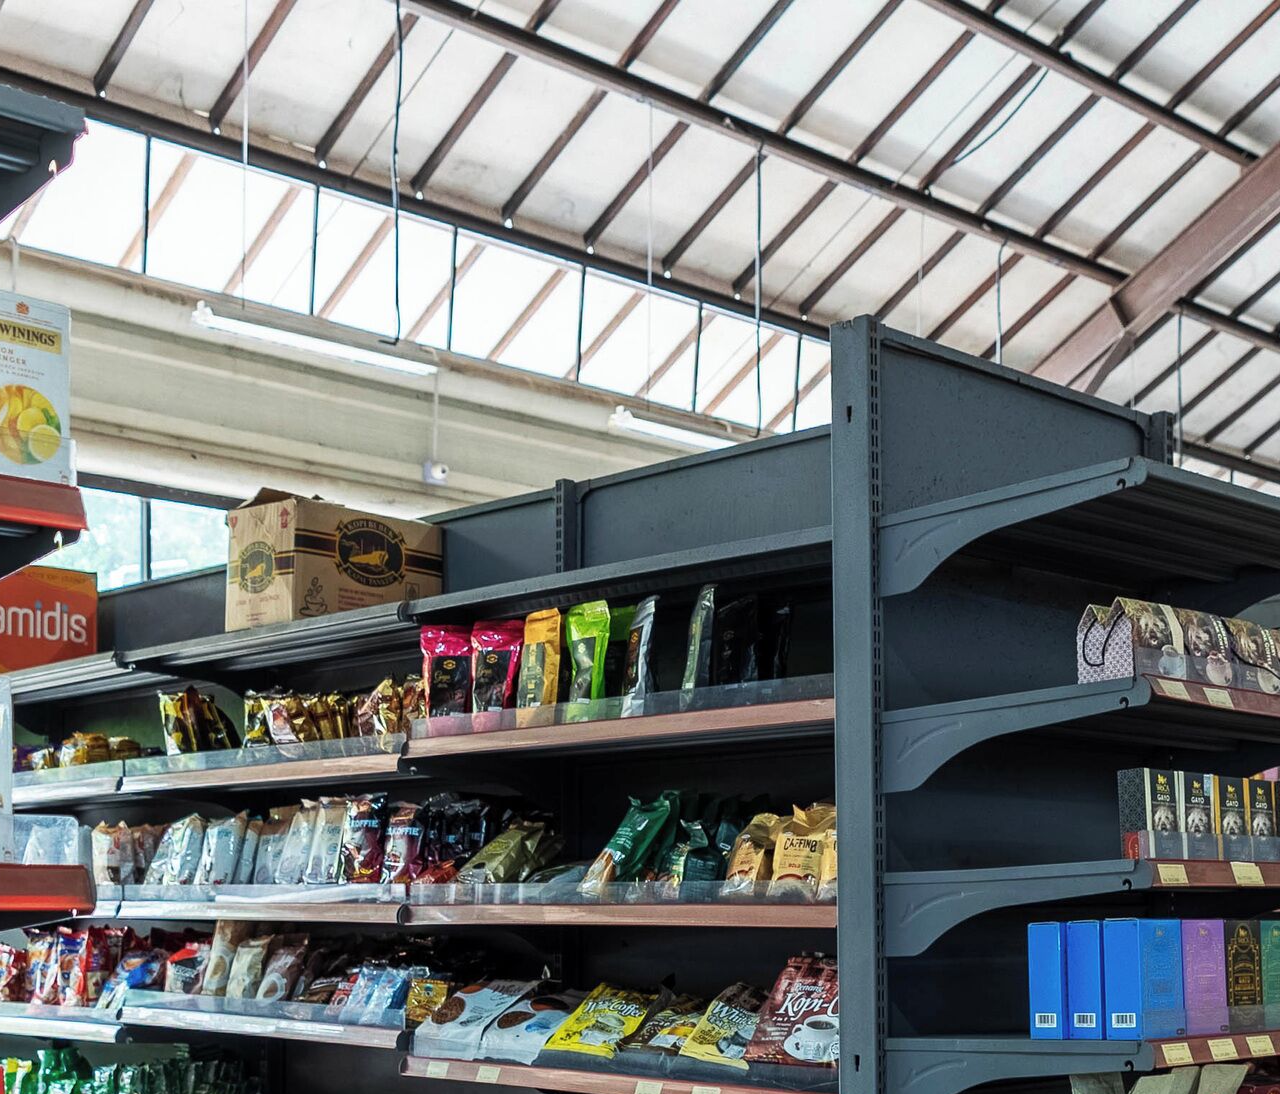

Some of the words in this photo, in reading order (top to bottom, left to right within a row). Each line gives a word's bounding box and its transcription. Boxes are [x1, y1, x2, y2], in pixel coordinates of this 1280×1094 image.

[1156, 793, 1170, 802] GAYO
[1190, 796, 1205, 804] GAYO
[1225, 800, 1239, 808] GAYO
[612, 1000, 645, 1018] Coffee
